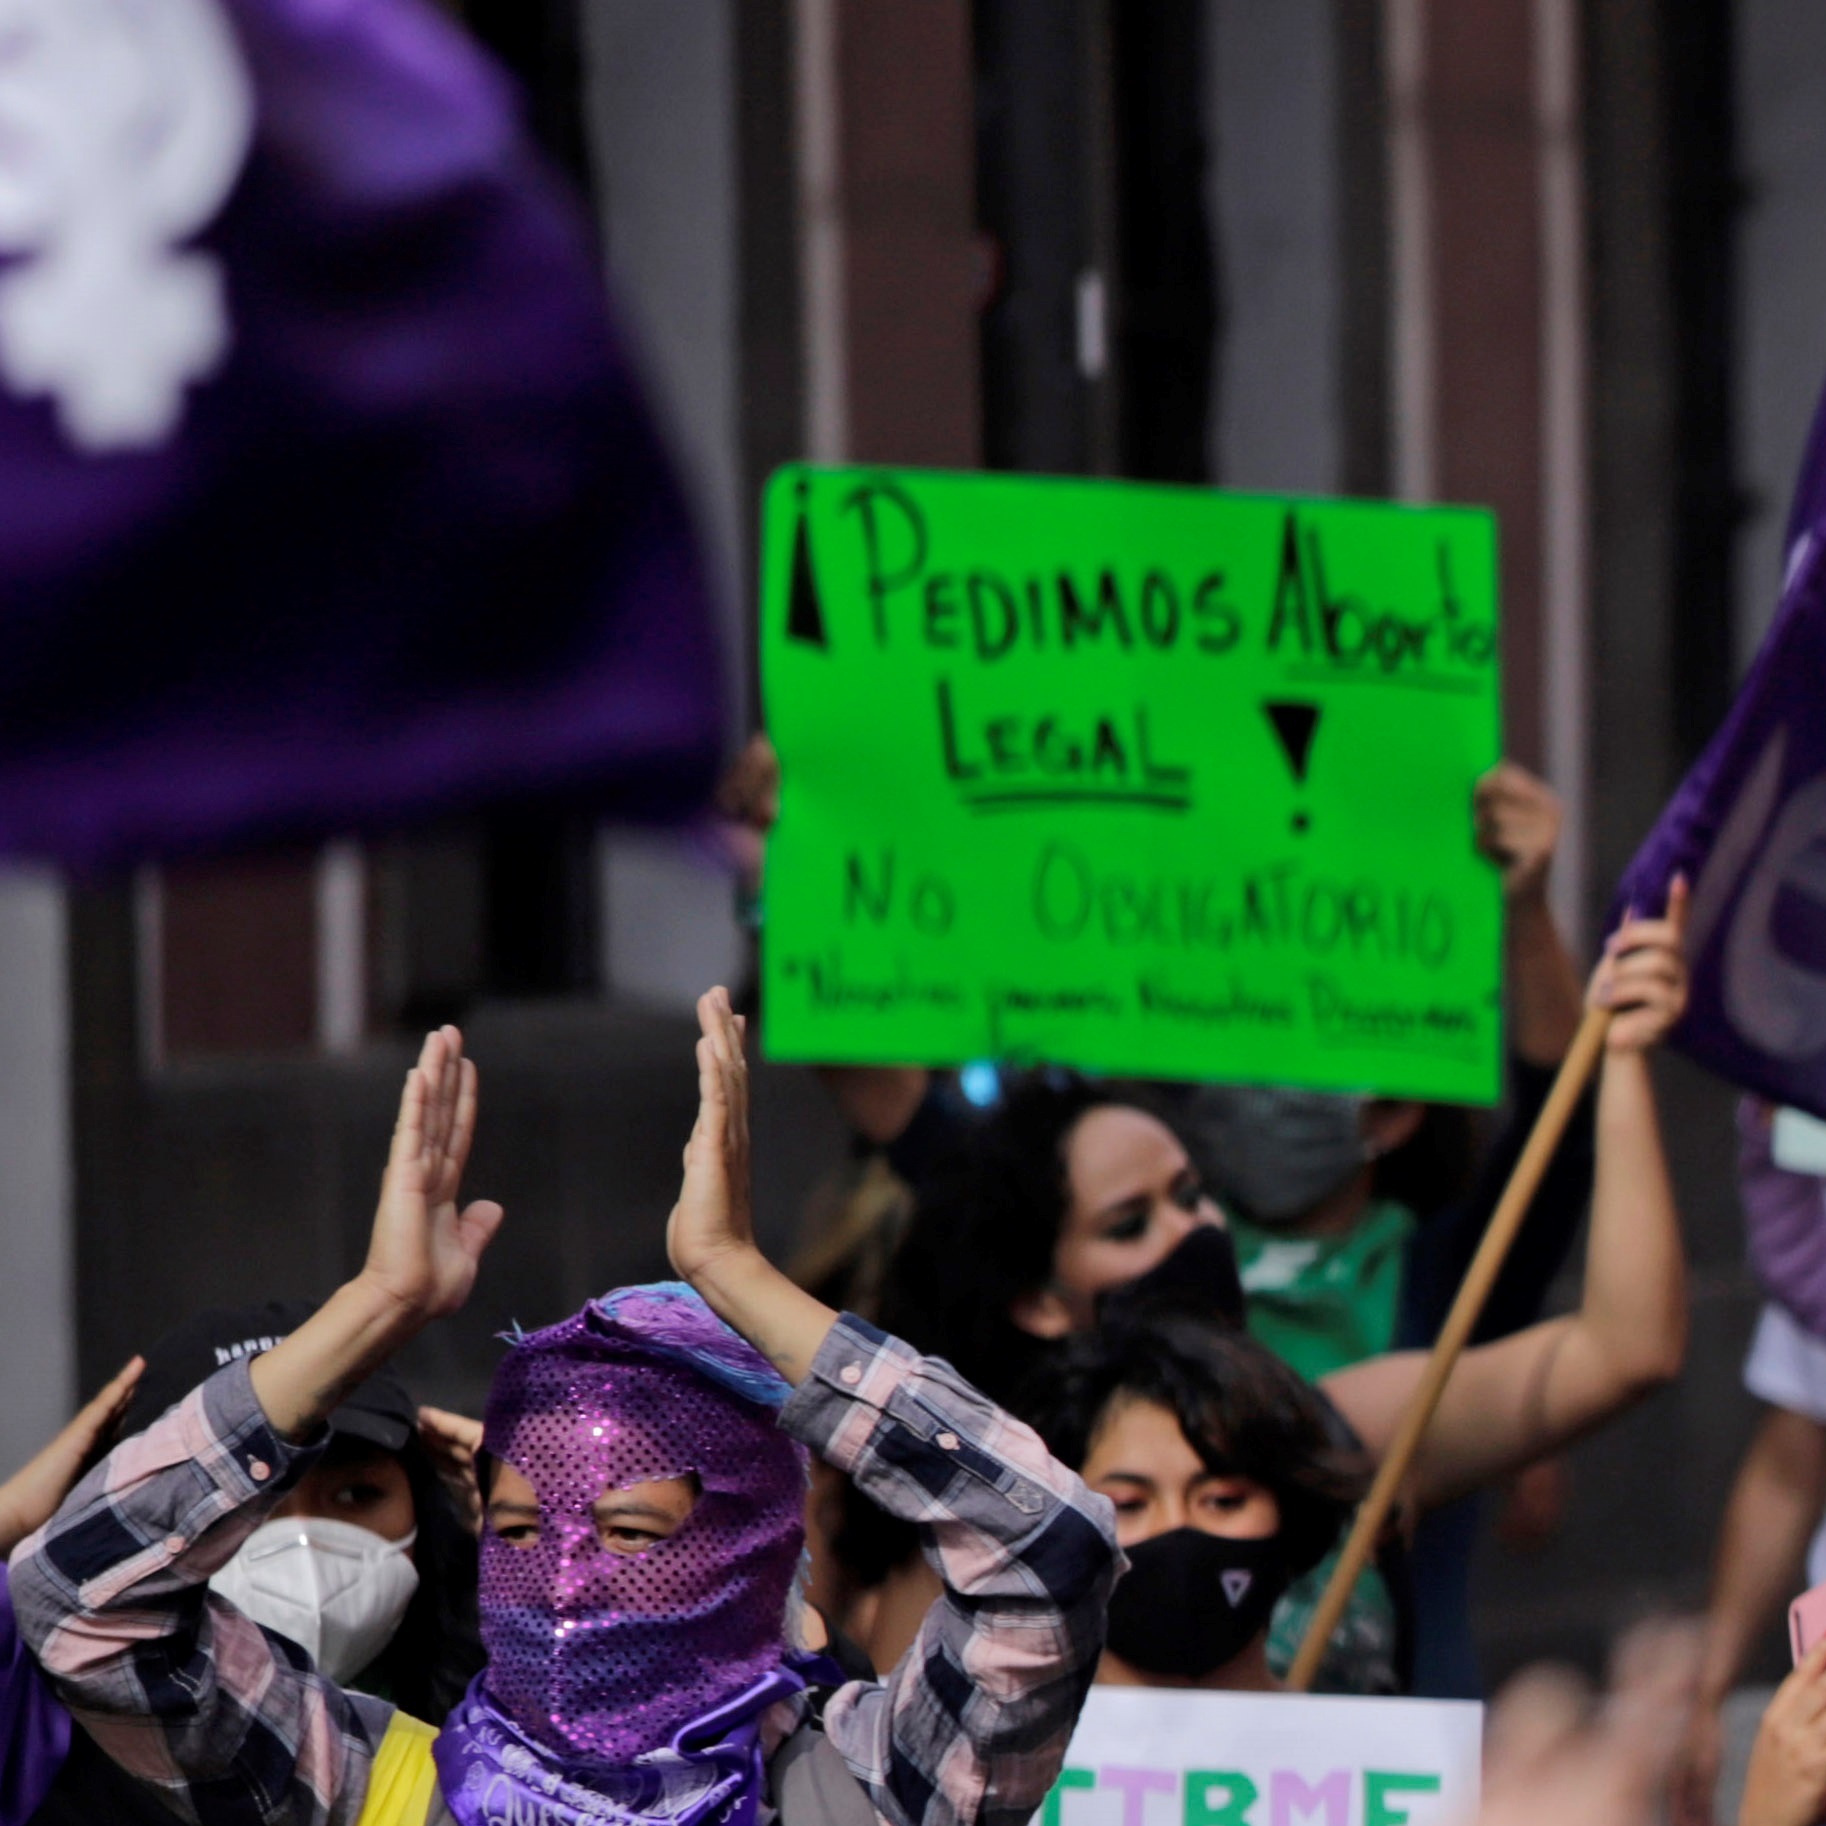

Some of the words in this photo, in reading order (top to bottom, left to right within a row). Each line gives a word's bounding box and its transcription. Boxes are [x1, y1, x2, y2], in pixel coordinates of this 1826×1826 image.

[1265, 510, 1496, 672] Aborto
[934, 678, 1190, 785] LEGAL
[843, 845, 955, 939] NO
